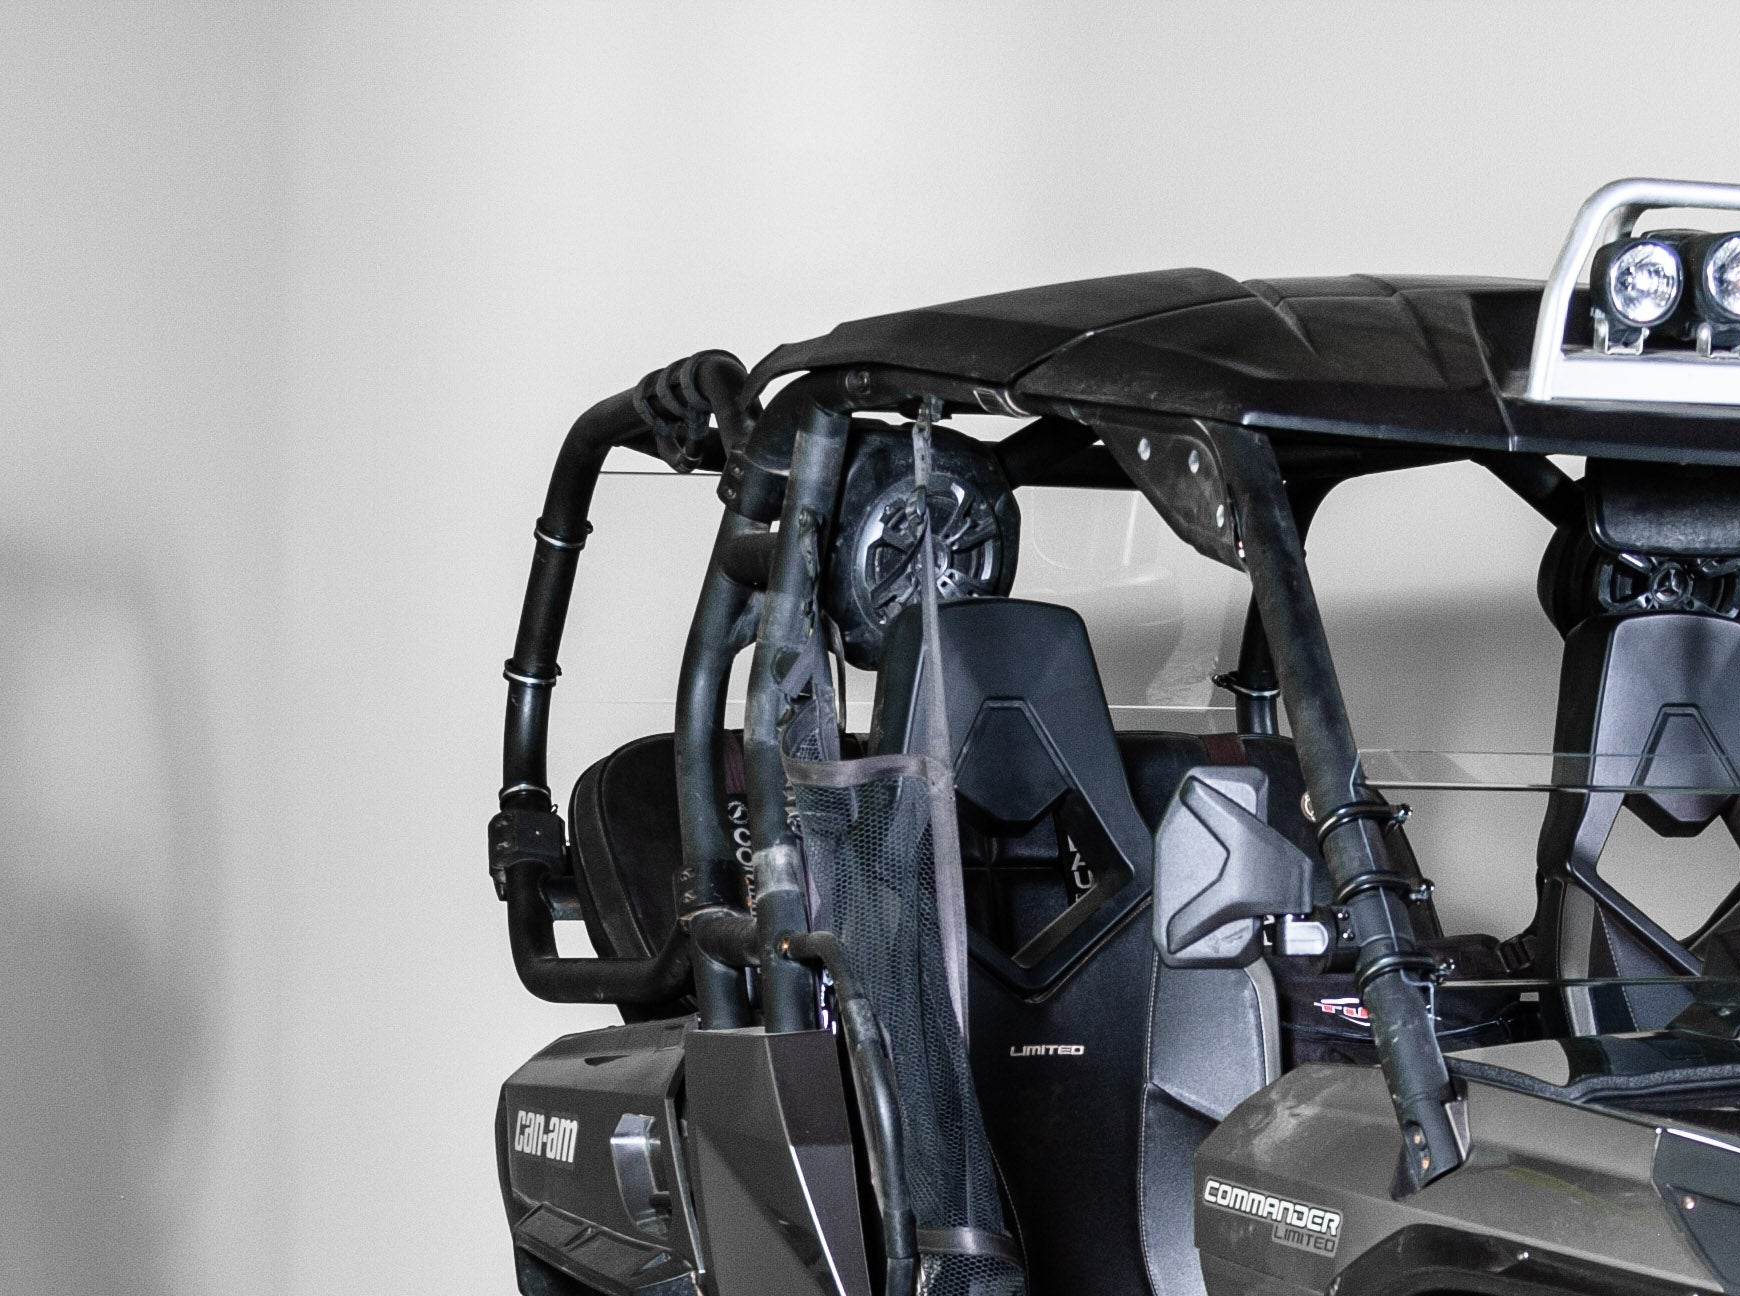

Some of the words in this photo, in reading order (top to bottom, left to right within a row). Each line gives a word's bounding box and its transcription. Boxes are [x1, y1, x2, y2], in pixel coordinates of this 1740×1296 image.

[1009, 1044, 1085, 1057] LIMITED
[514, 1109, 579, 1163] can-am
[1203, 1179, 1341, 1237] COMMANDER
[1273, 1226, 1336, 1253] LIMITED
